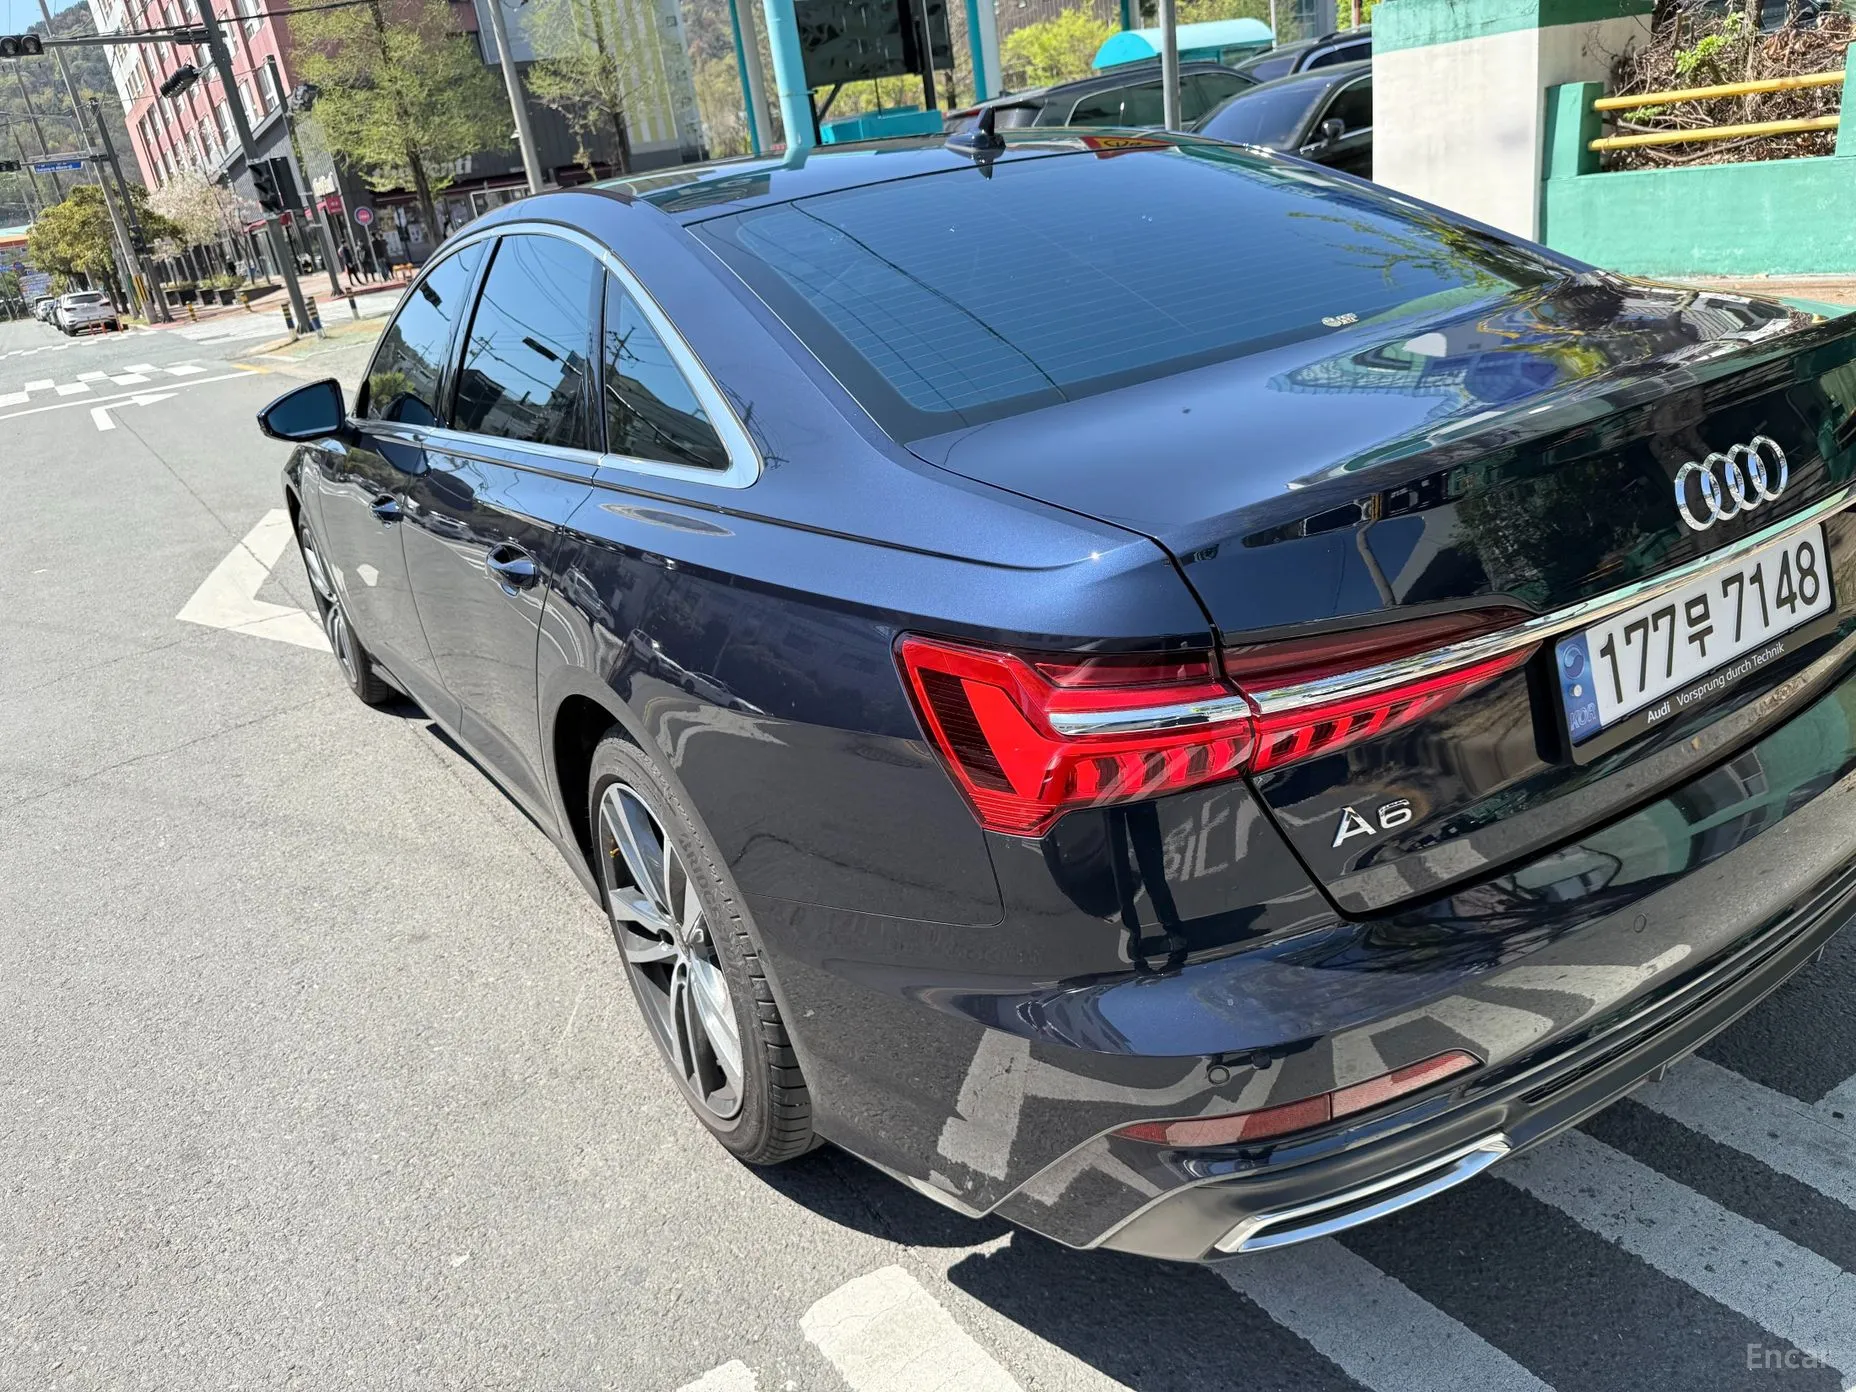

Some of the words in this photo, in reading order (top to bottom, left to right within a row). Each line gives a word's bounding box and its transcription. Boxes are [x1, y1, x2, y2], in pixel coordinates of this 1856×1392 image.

[1721, 541, 1821, 643] 7148
[1646, 703, 1671, 724] Audi
[1676, 675, 1726, 708] Vorsprung
[1726, 660, 1751, 683] durch
[1751, 642, 1785, 668] Technik
[1569, 708, 1598, 732] KOR
[1332, 798, 1413, 849] A6
